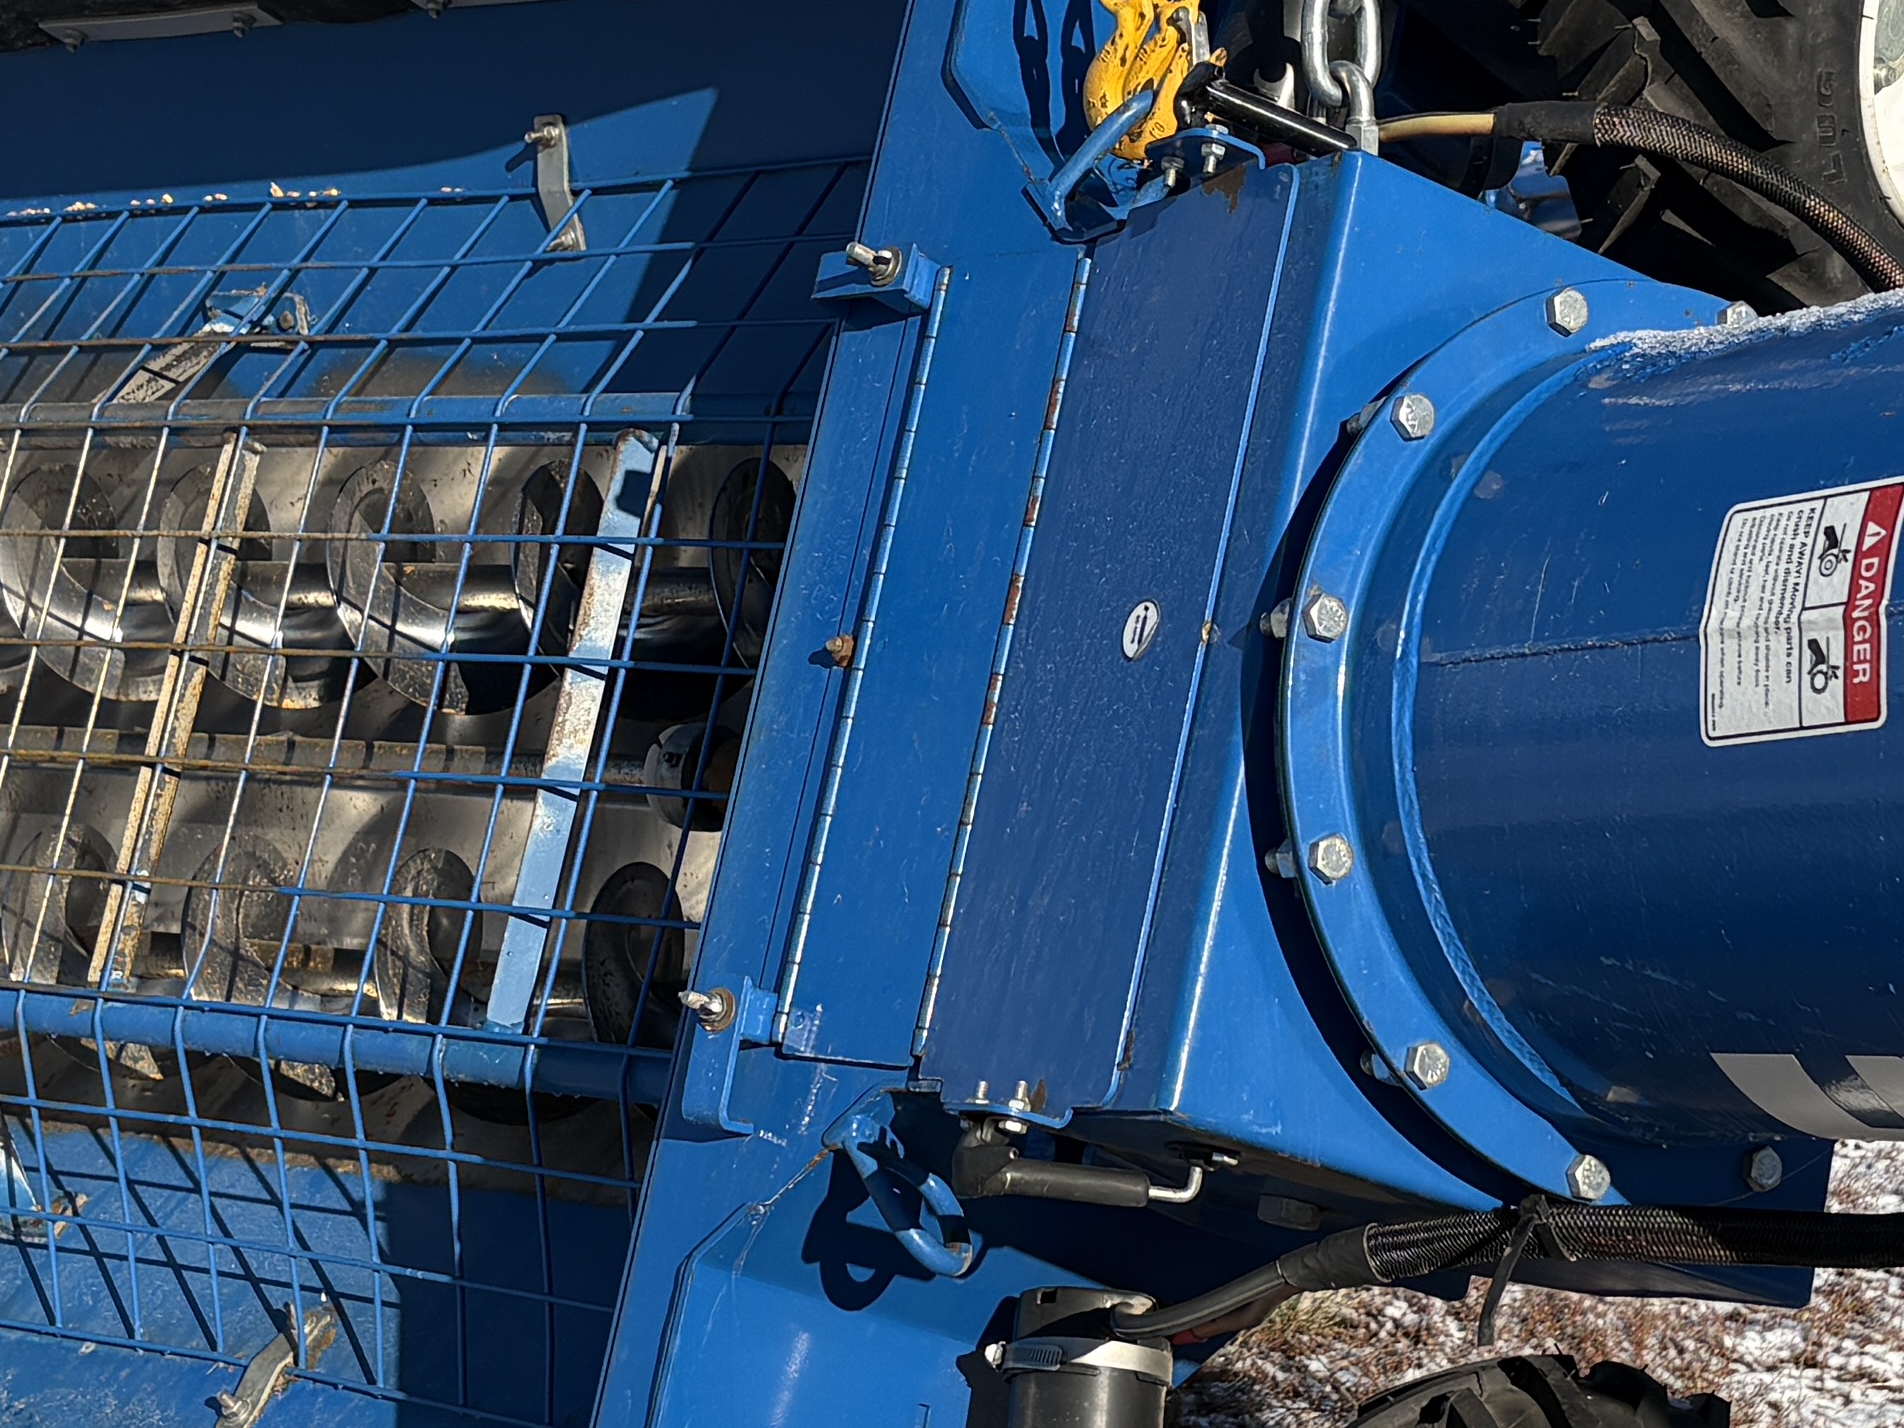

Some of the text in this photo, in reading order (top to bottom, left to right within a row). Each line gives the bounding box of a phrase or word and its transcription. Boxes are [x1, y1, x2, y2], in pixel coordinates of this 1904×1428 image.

[1815, 68, 1848, 185] LUG
[1791, 510, 1804, 540] crush
[1803, 508, 1816, 538] KEEP
[1786, 544, 1795, 564] and
[1796, 542, 1807, 578] AWAY!
[1784, 582, 1800, 623] Moving
[1852, 557, 1880, 684] DANGER
[1785, 627, 1793, 658] parts
